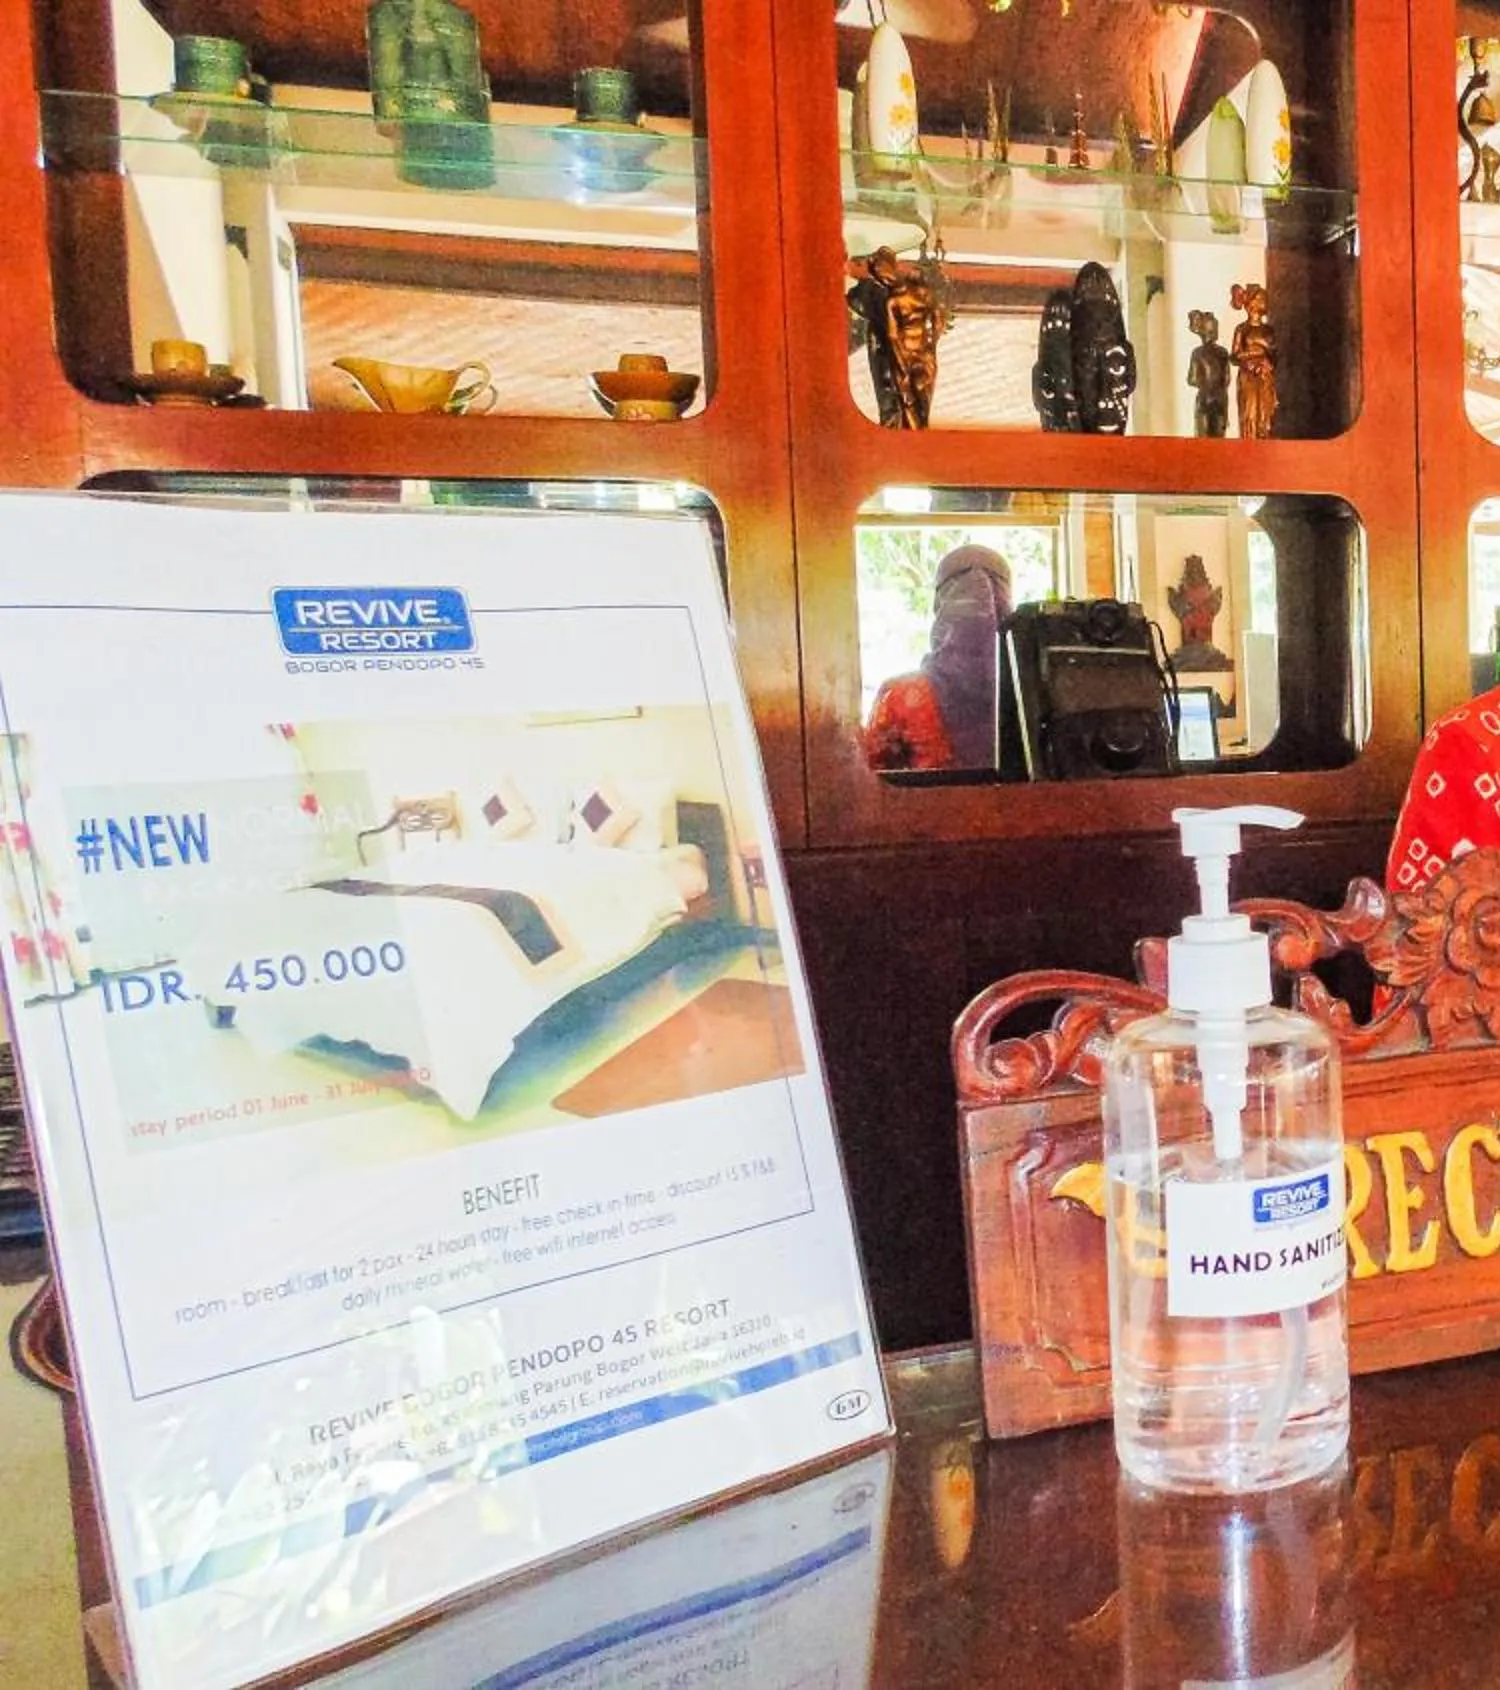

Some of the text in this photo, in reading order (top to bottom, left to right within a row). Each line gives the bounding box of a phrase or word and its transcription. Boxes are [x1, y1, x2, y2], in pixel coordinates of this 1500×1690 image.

[296, 598, 442, 626] REVIVE
[319, 631, 439, 652] RESORT
[285, 656, 486, 675] BOGOR PENDOPO 45
[75, 812, 212, 875] #NEW
[100, 941, 406, 1014] IDR. 450.000
[174, 1103, 239, 1133] period
[462, 1172, 541, 1215] BENEFIT
[174, 1298, 228, 1324] room
[357, 1257, 369, 1277] 2
[417, 1243, 434, 1263] 24
[480, 1224, 509, 1246] stay
[521, 1212, 555, 1233] free
[556, 1199, 602, 1225] check
[624, 1189, 656, 1209] time
[341, 1284, 383, 1313] daily
[502, 1246, 533, 1265] free
[566, 1219, 625, 1249] internet
[1190, 1227, 1345, 1275] HAND SANITIZ
[491, 1334, 605, 1386] PENDOPO
[610, 1326, 638, 1347] 45
[644, 1298, 732, 1339] RESORT
[533, 1368, 593, 1398] Parung
[597, 1351, 647, 1379] Bogor
